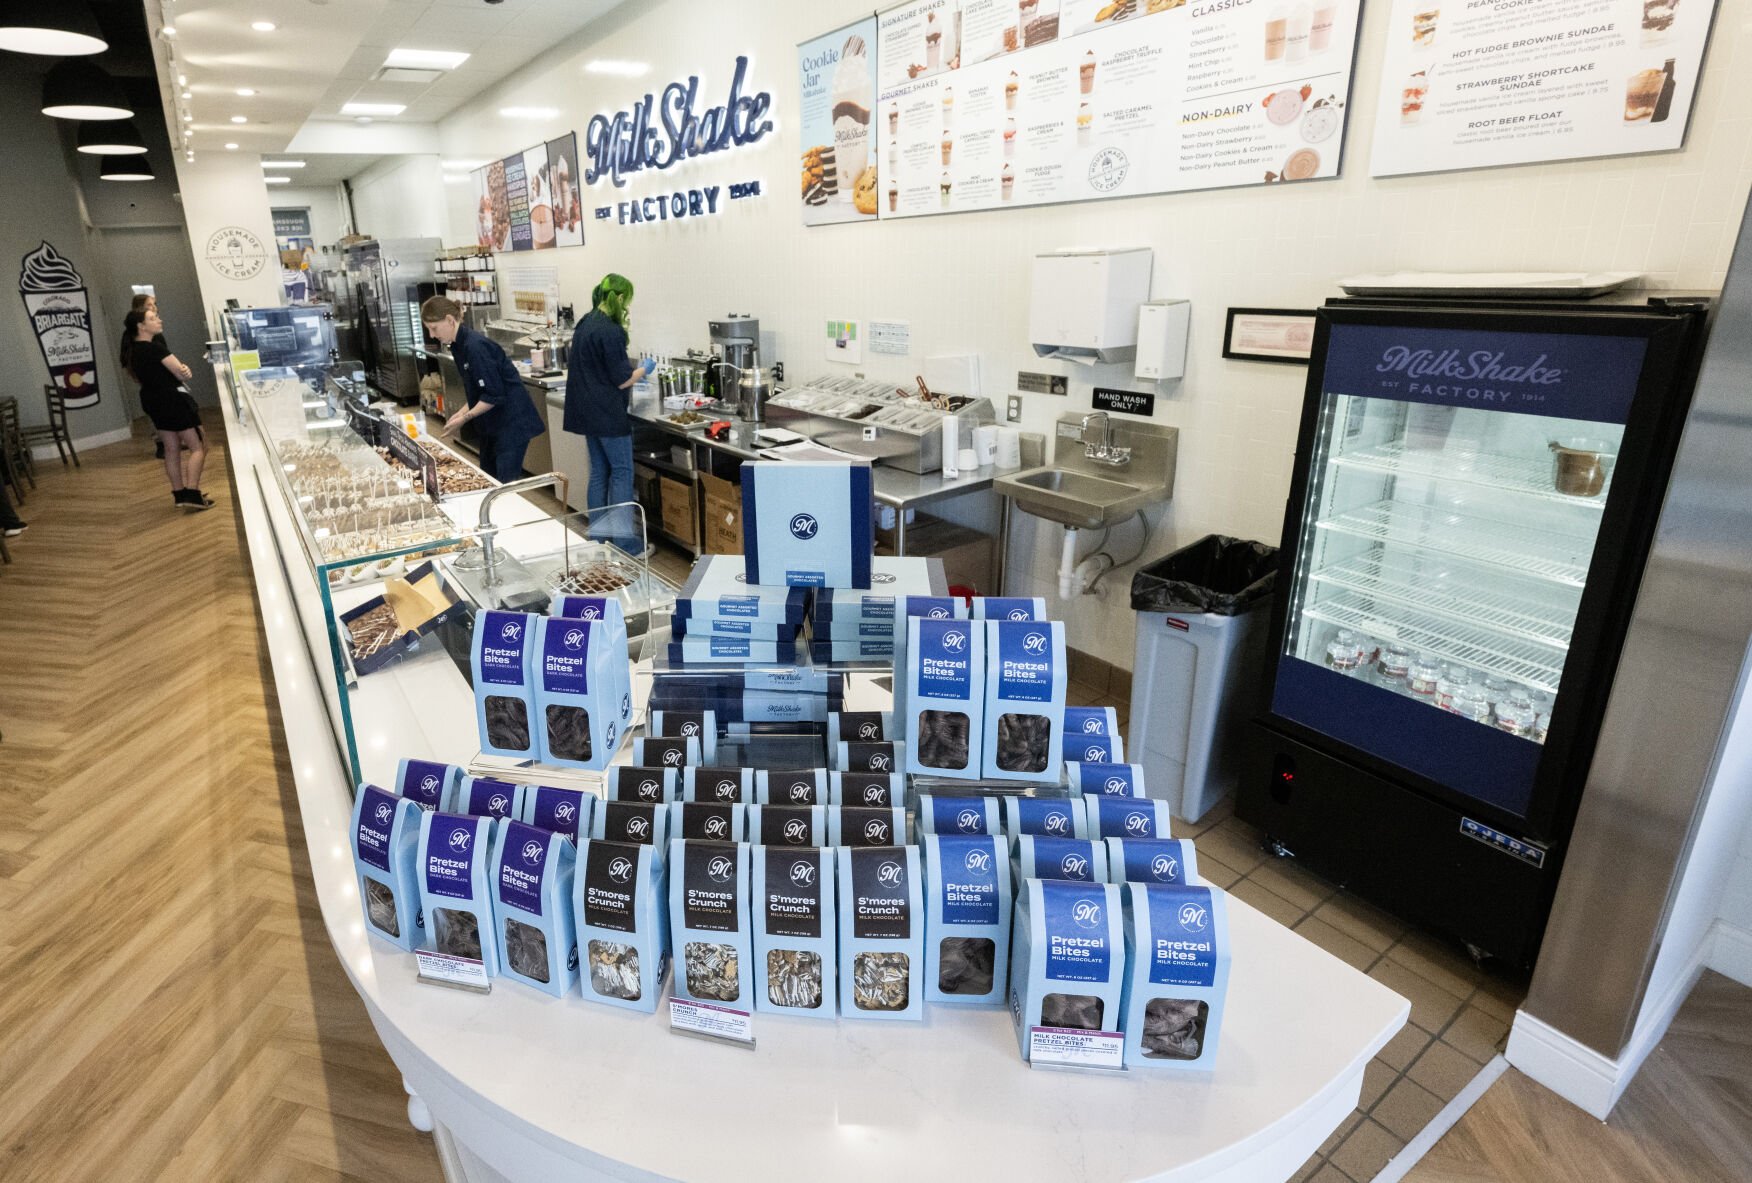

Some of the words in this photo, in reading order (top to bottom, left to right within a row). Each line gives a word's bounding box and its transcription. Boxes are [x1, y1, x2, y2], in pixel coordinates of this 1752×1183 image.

[881, 9, 916, 28] SIGNATURE
[917, 0, 946, 16] SHAKES
[1192, 26, 1213, 36] Vanilla
[1190, 35, 1224, 47] Chocolate
[1452, 50, 1472, 59] HOT
[1475, 42, 1510, 54] FUDGE
[1512, 33, 1564, 48] BROWNIE
[1568, 24, 1614, 38] SUNDAE
[1102, 55, 1134, 66] RASPBERRY
[1137, 48, 1162, 57] TRUFFLE
[1114, 46, 1148, 57] CHOCOLATE
[1189, 45, 1226, 58] Strawberry
[802, 48, 839, 73] Cookie
[1204, 58, 1220, 68] Chip
[1029, 72, 1048, 80] PEANUT
[1049, 67, 1067, 75] BUTTER
[1187, 71, 1220, 82] Raspberry
[1456, 74, 1524, 91] STRAWBERRY
[1528, 62, 1595, 80] SHORTCAKE
[803, 71, 820, 89] Jar
[1186, 83, 1212, 92] Cookies
[1220, 76, 1243, 85] Cream
[1500, 79, 1542, 92] SUNDAE
[881, 86, 911, 100] GOURMET
[913, 79, 938, 92] SHAKES
[1125, 105, 1152, 113] CARAMEL
[1183, 103, 1253, 122] NON-DAIRY
[1468, 120, 1496, 128] ROOT
[1499, 116, 1526, 125] BEER
[1529, 110, 1563, 122] FLOAT
[1182, 130, 1214, 140] Non-Dairy
[1216, 124, 1250, 134] Chocolate
[1182, 142, 1213, 150] Non-Dairy
[1216, 136, 1252, 146] Strawberry
[1092, 150, 1124, 172] HOUSEMADE
[1180, 152, 1212, 162] Non-Dairy
[1179, 164, 1211, 172] Non-Dairy
[1239, 158, 1260, 166] Butter
[1106, 170, 1124, 188] CREAM
[618, 186, 720, 224] FACTORY
[211, 230, 259, 251] HOUSEMADE
[216, 262, 230, 274] ICE
[234, 260, 262, 278] CREAM
[34, 313, 88, 332] BRIARGATE
[1098, 392, 1120, 400] HAND
[1122, 395, 1146, 404] WASH
[1409, 384, 1511, 401] FACTORY
[1111, 401, 1132, 410] ONLY
[719, 528, 736, 538] HEATH
[484, 648, 520, 657] Pretzel
[484, 656, 510, 664] Bites
[546, 656, 582, 666] Pretzel
[924, 658, 966, 669] Pretzel
[546, 664, 572, 672] Bites
[924, 667, 954, 676] Bites
[1004, 661, 1048, 672] Pretzel
[1004, 670, 1036, 678] Bites
[360, 824, 388, 843] Pretzel
[360, 834, 380, 847] Bites
[1468, 822, 1536, 858] OJEDA
[429, 856, 468, 870] Pretzel
[429, 864, 458, 876] Bites
[503, 864, 539, 884] Pretzel
[502, 873, 528, 889] Bites
[588, 887, 630, 901] S'mores
[946, 883, 993, 893] Pretzel
[688, 889, 732, 900] S'mores
[770, 894, 816, 906] S'mores
[946, 892, 981, 902] Bites
[588, 896, 624, 908] Crunch
[688, 898, 727, 908] Crunch
[858, 896, 905, 906] S'mores
[600, 906, 629, 915] CHOCOLATE
[770, 903, 810, 914] Crunch
[858, 906, 900, 915] Crunch
[1052, 936, 1104, 948] Pretzel
[1157, 940, 1210, 952] Pretzel
[1052, 946, 1090, 956] Bites
[1157, 950, 1196, 960] Bites
[672, 1004, 698, 1012] S'MORES
